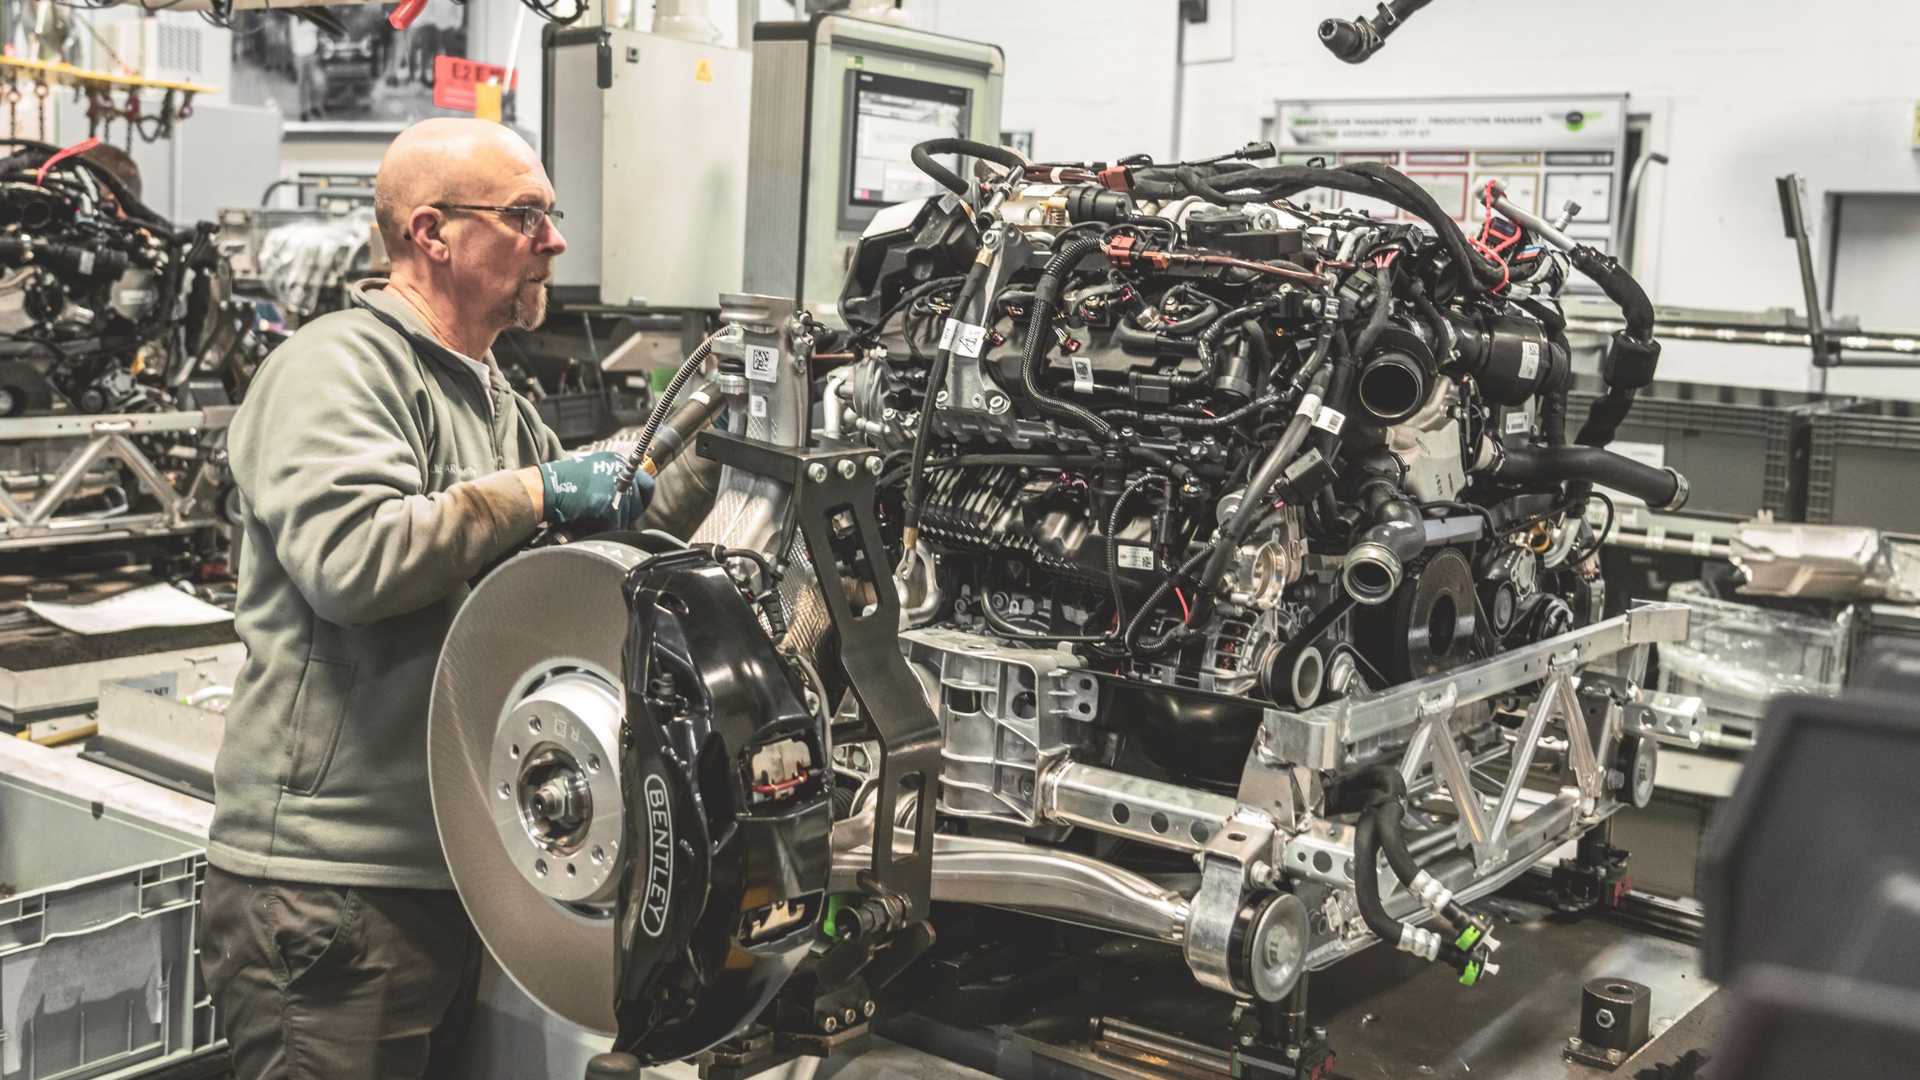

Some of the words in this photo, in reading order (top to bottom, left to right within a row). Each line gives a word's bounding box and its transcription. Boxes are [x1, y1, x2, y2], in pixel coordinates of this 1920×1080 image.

[1354, 117, 1417, 126] MANAGEMENT
[1428, 116, 1490, 125] PRODUCTION
[1493, 116, 1543, 124] MANAGER
[649, 789, 671, 923] BENTLEY
